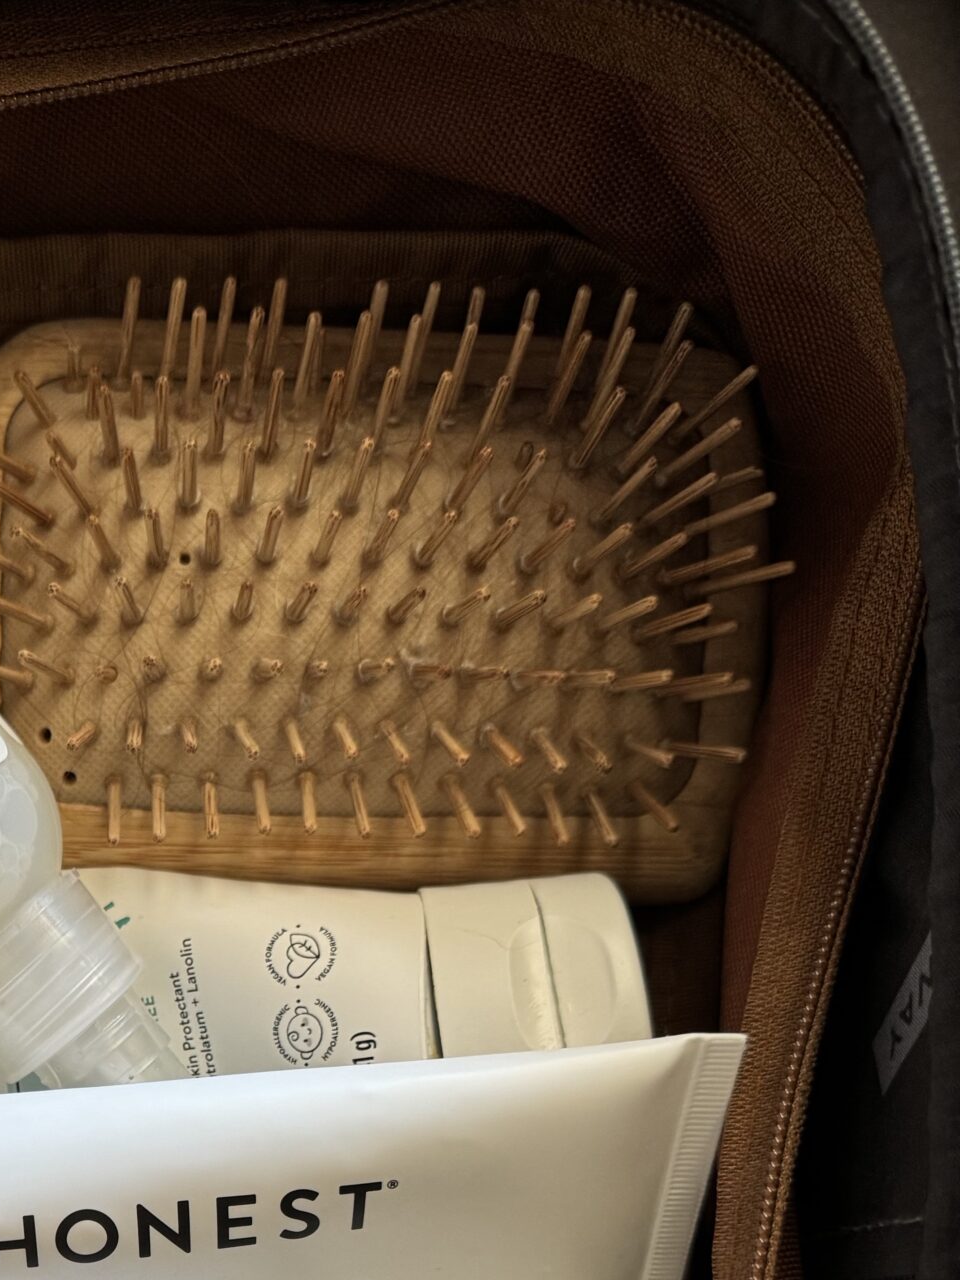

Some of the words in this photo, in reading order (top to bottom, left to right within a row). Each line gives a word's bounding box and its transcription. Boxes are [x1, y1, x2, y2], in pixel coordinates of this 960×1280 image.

[265, 928, 287, 959] FORMULA
[319, 926, 338, 957] FORMULA
[180, 938, 198, 993] Lanolin
[265, 957, 287, 986] VEGAN
[315, 957, 336, 982] VEGAN
[169, 971, 195, 1051] Protectant
[314, 998, 339, 1062] HYPOALLERGENIC
[195, 1011, 216, 1076] trolatum
[272, 1003, 298, 1065] HYPOALLERGENIC
[186, 1055, 200, 1078] kin
